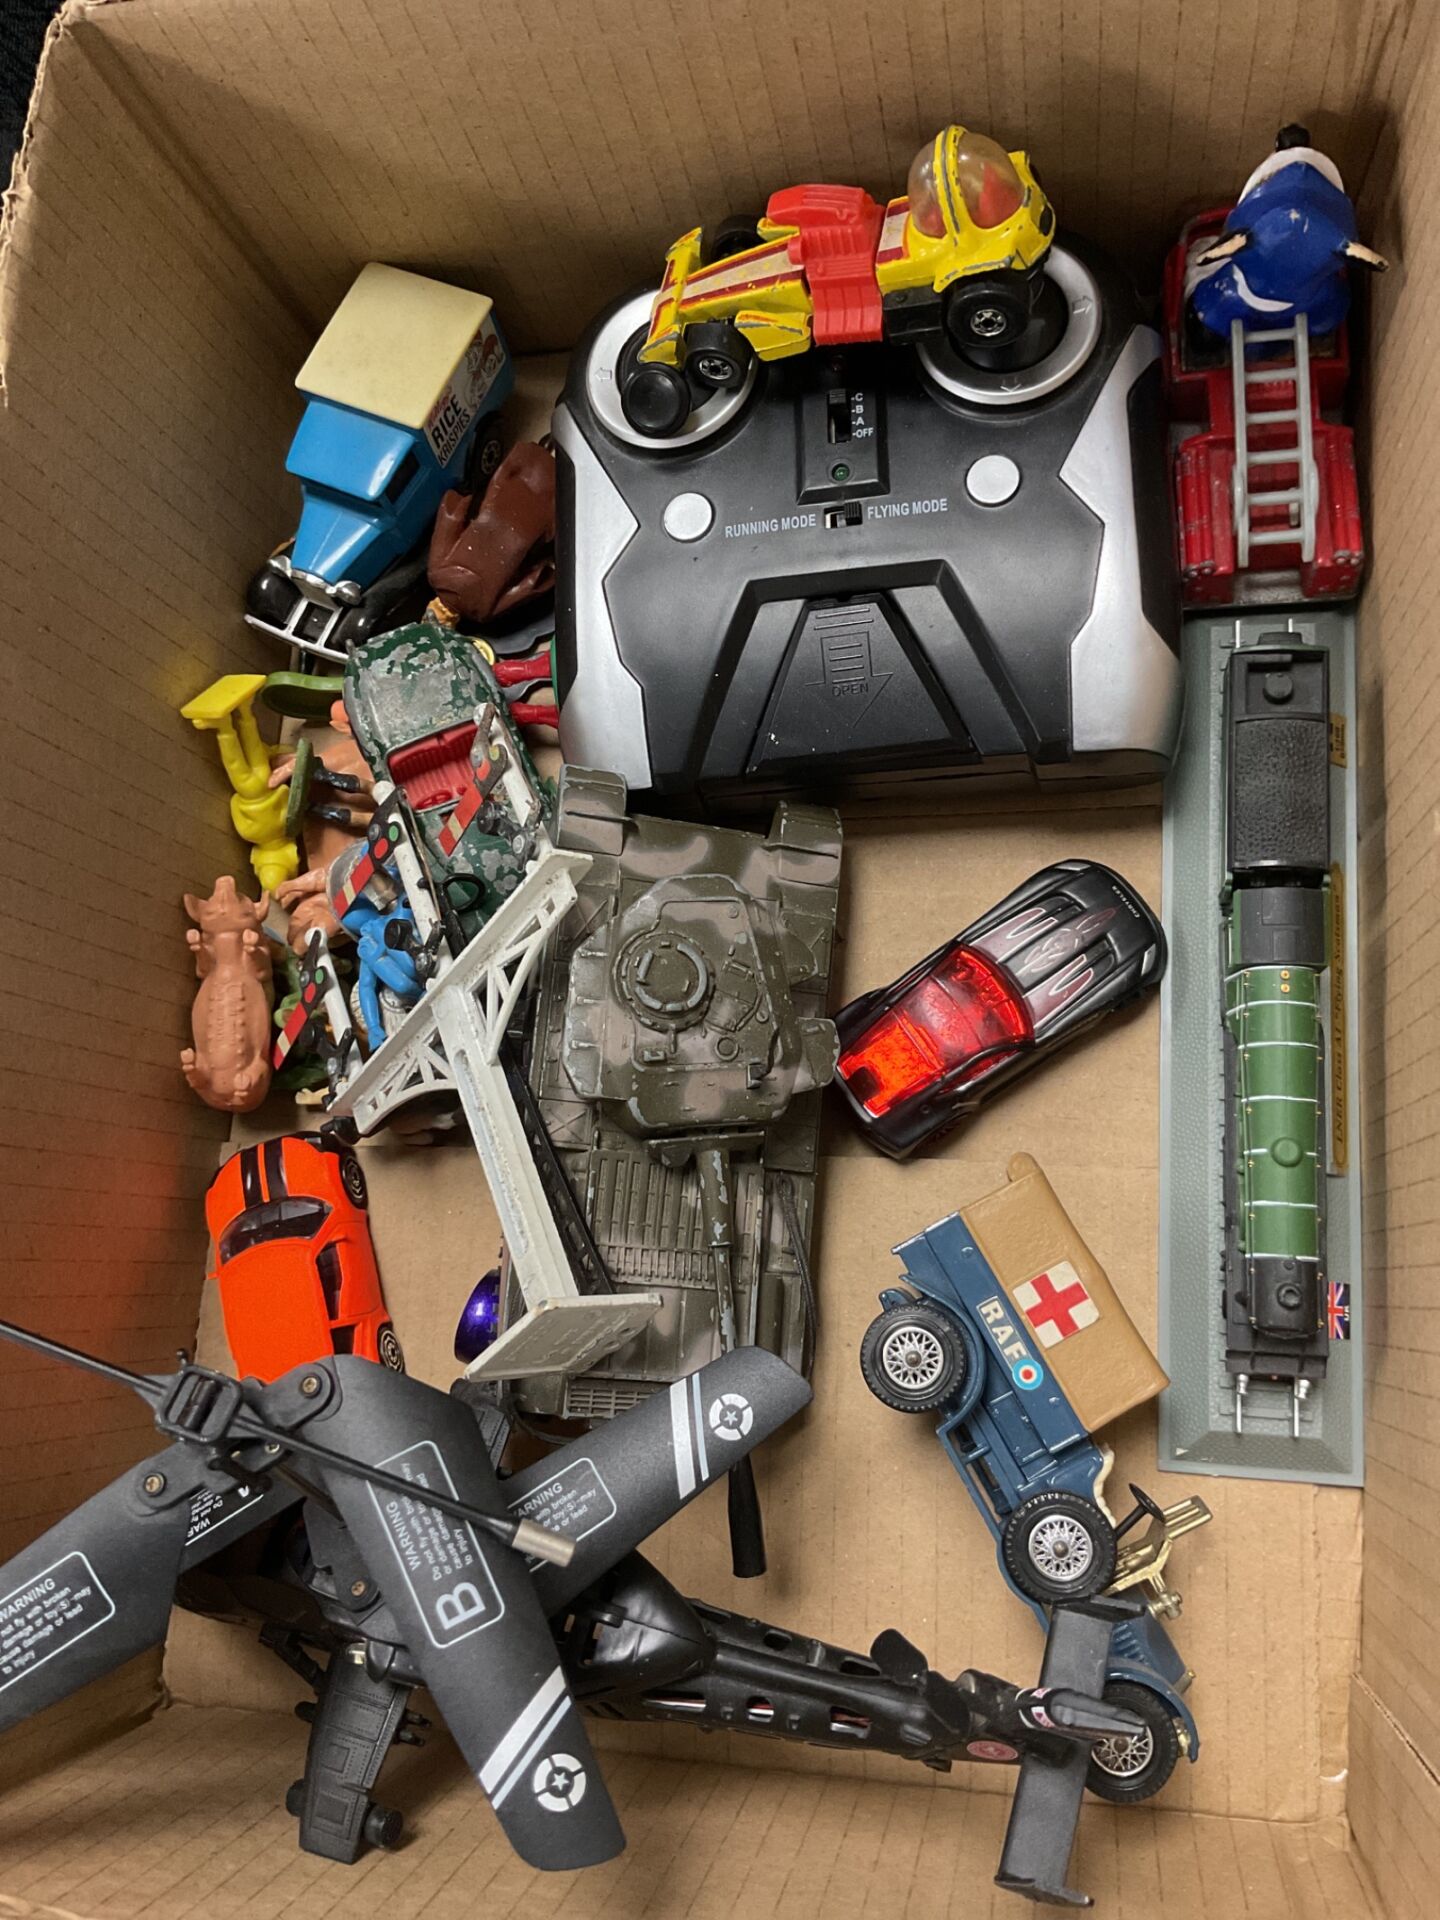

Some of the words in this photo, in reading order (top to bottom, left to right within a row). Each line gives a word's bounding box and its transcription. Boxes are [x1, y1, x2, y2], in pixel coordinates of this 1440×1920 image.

[431, 393, 462, 449] RICE
[438, 408, 470, 466] KRISPIES
[867, 503, 910, 519] FLYING
[912, 498, 948, 515] MODE
[724, 518, 779, 538] RUNNING
[781, 514, 817, 531] MODE
[831, 682, 869, 697] OPEN
[980, 1300, 1028, 1360] RAF
[551, 1489, 577, 1510] broken
[570, 1504, 589, 1519] lead
[386, 1501, 421, 1572] WARNING
[431, 1507, 451, 1541] damag
[428, 1526, 448, 1562] damage
[453, 1529, 469, 1554] injury
[423, 1549, 436, 1565] not
[447, 1542, 463, 1569] cause
[464, 1554, 474, 1566] to
[432, 1566, 442, 1581] Do
[42, 1586, 72, 1608] broken
[435, 1581, 486, 1631] B
[2, 1624, 34, 1649] damage
[22, 1623, 55, 1648] damage
[63, 1603, 84, 1620] lead
[13, 1650, 36, 1668] injury
